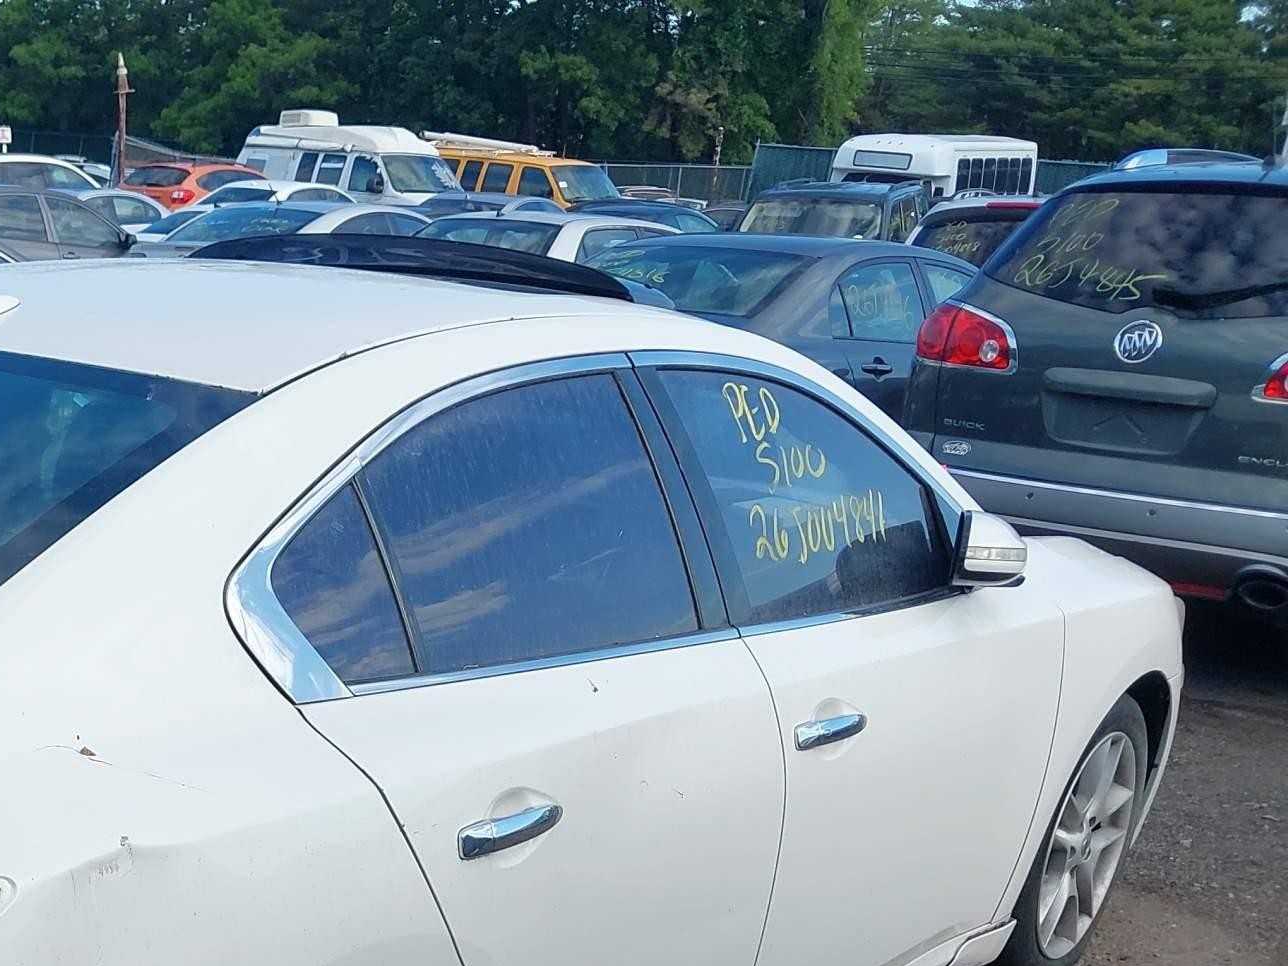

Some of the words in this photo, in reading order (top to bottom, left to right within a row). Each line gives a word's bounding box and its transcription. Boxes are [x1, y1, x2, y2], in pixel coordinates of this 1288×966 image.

[1048, 197, 1120, 230] PED
[1014, 253, 1169, 302] 26J4845
[722, 381, 781, 443] PED
[943, 418, 986, 431] BUICK
[755, 434, 827, 494] S100
[748, 489, 887, 565] 26J004841
